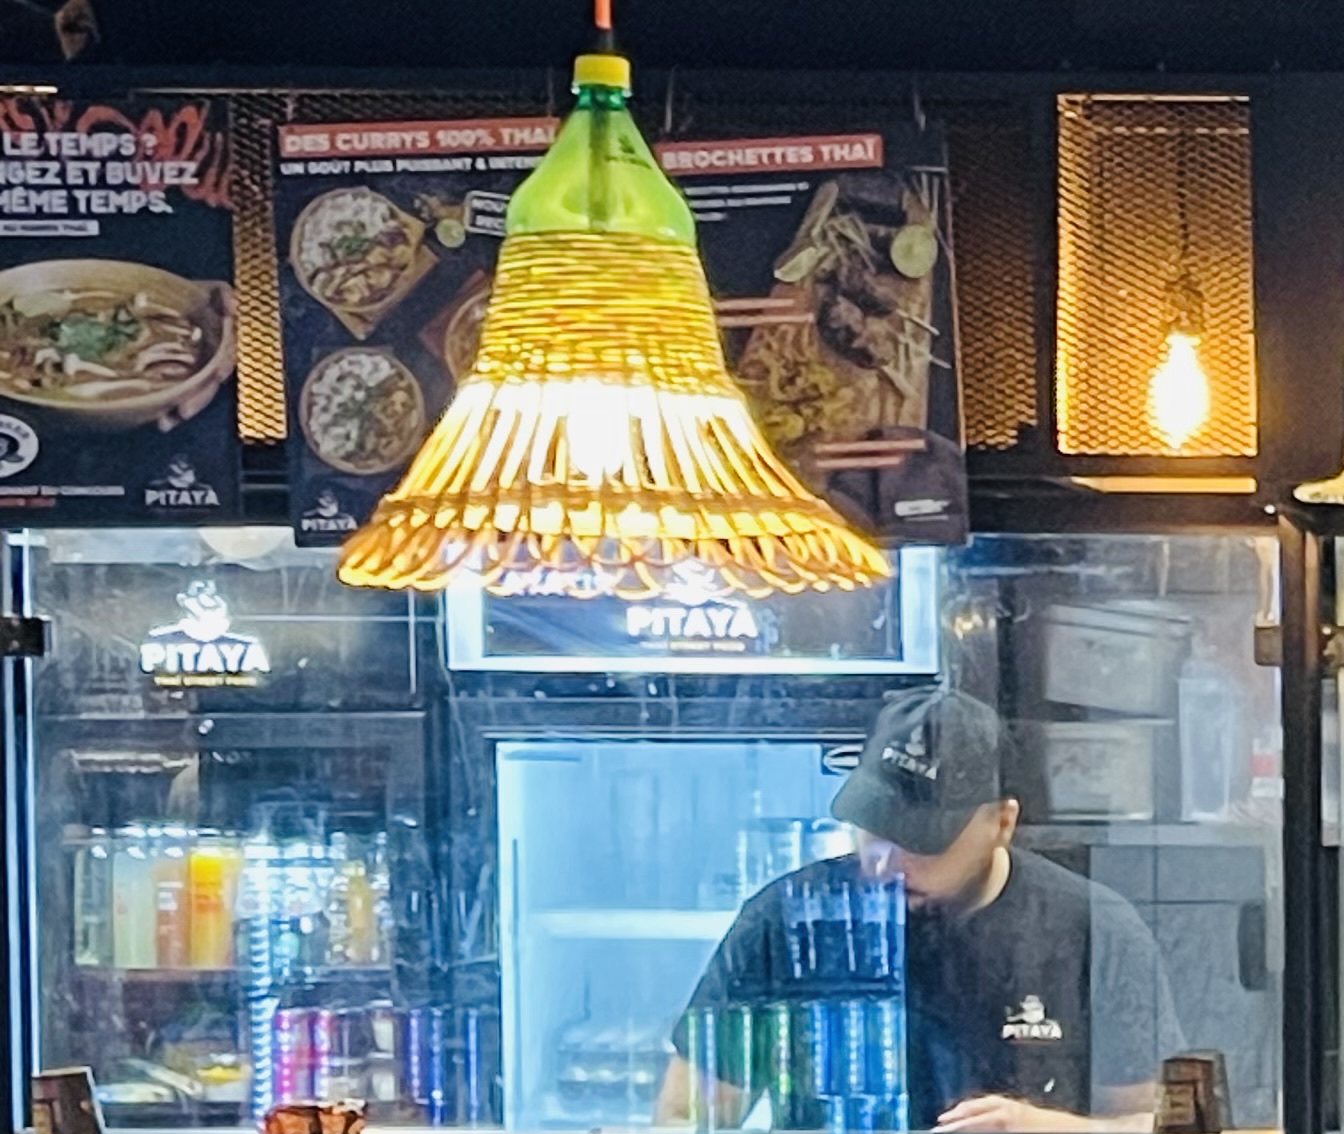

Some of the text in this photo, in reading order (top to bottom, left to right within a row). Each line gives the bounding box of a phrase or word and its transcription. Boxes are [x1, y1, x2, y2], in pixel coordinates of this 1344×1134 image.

[3, 131, 158, 157] LE TEMPS ?
[284, 133, 330, 152] DES
[335, 131, 430, 150] CURRYS
[436, 129, 496, 147] 100%
[661, 145, 814, 169] BROCHETTES
[818, 138, 876, 162] THAÏ
[65, 161, 102, 185] ET
[105, 160, 199, 185] BUVEZ
[144, 489, 221, 507] PITAYA
[301, 517, 359, 531] PITAYA
[626, 604, 758, 637] PITAYA
[139, 642, 271, 674] PITAYA
[1002, 1022, 1063, 1040] PITAYA
